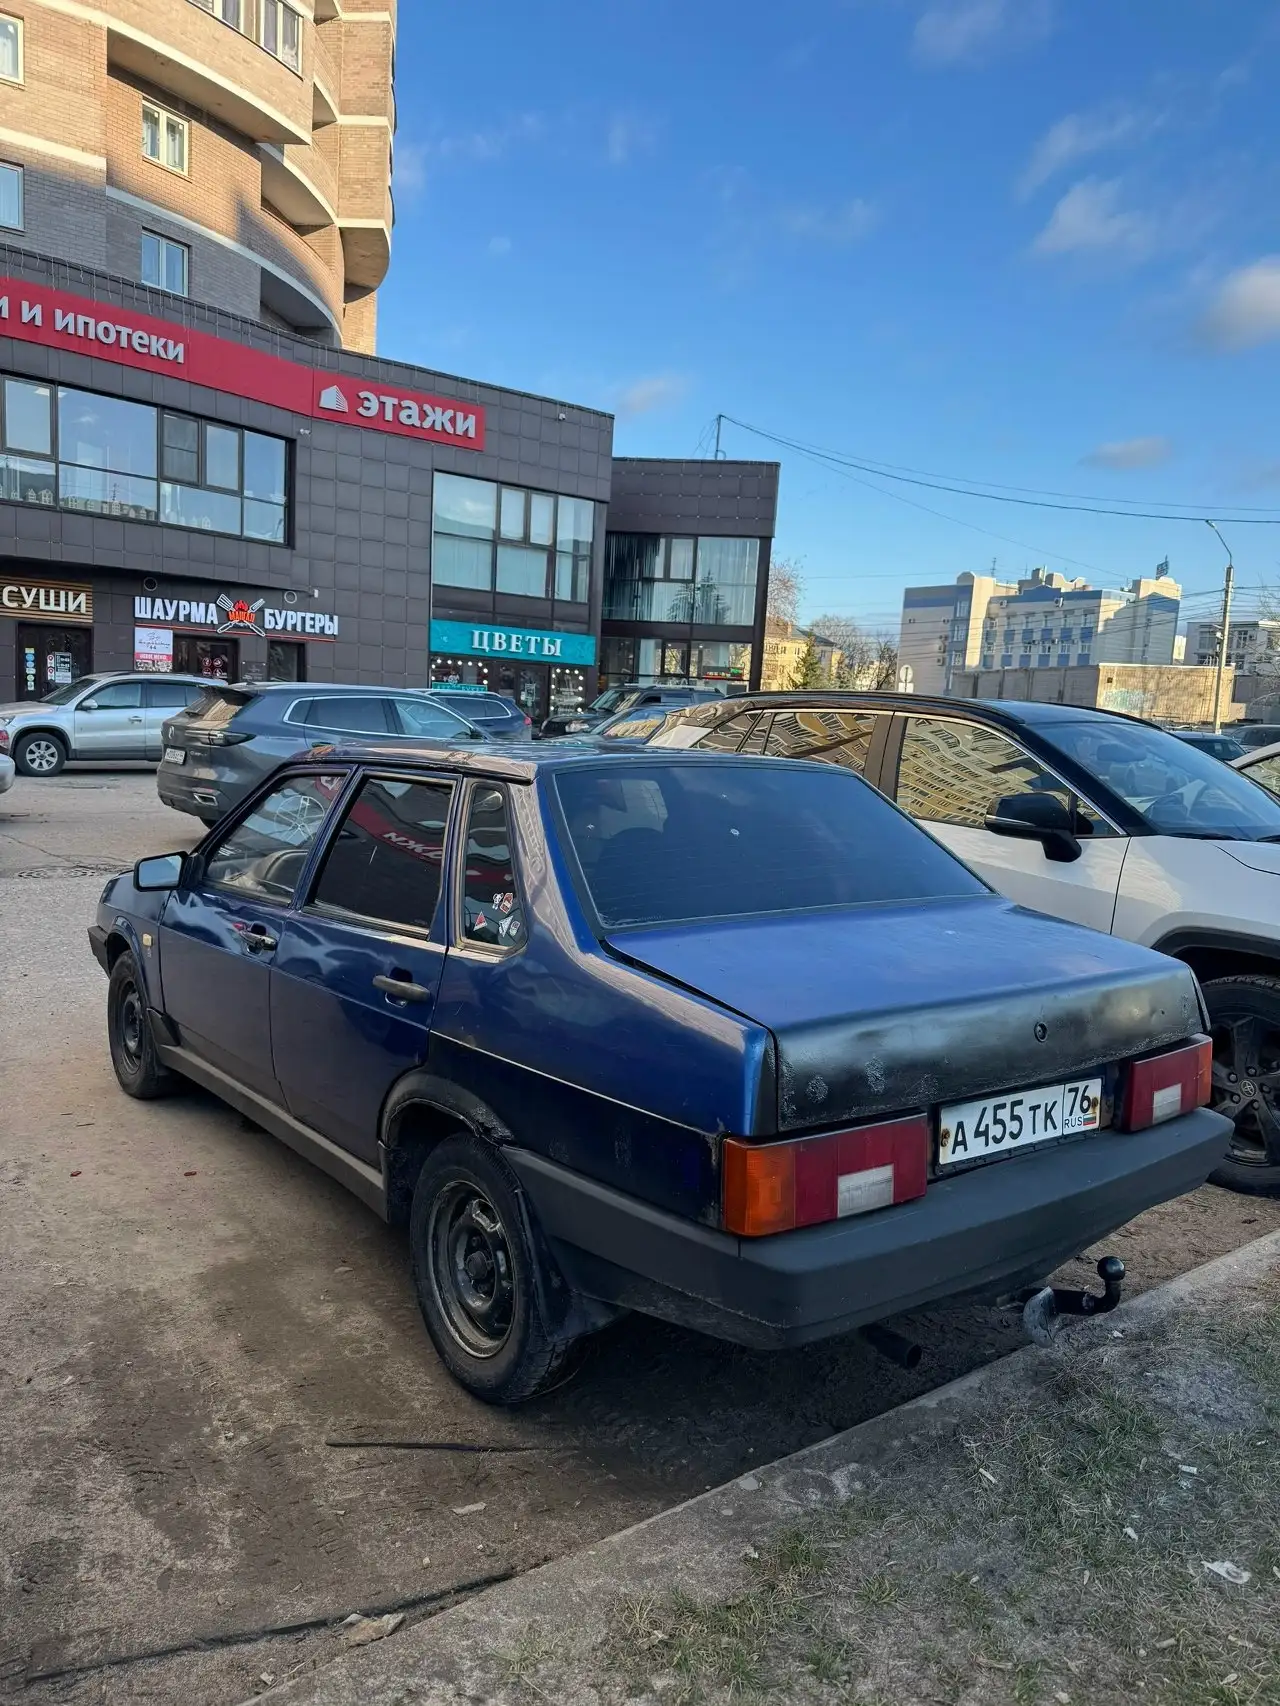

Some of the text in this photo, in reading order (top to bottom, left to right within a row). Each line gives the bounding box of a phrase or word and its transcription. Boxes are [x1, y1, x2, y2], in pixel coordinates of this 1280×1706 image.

[54, 308, 185, 364] ипотеки
[356, 390, 476, 438] этажи
[2, 585, 87, 614] СУШИ
[134, 596, 219, 625] ШАУРМА
[264, 608, 339, 636] БУРГЕРЫ
[471, 630, 563, 657] ЦВЕТЫ
[1067, 1085, 1091, 1117] 76
[1064, 1116, 1083, 1129] RUS
